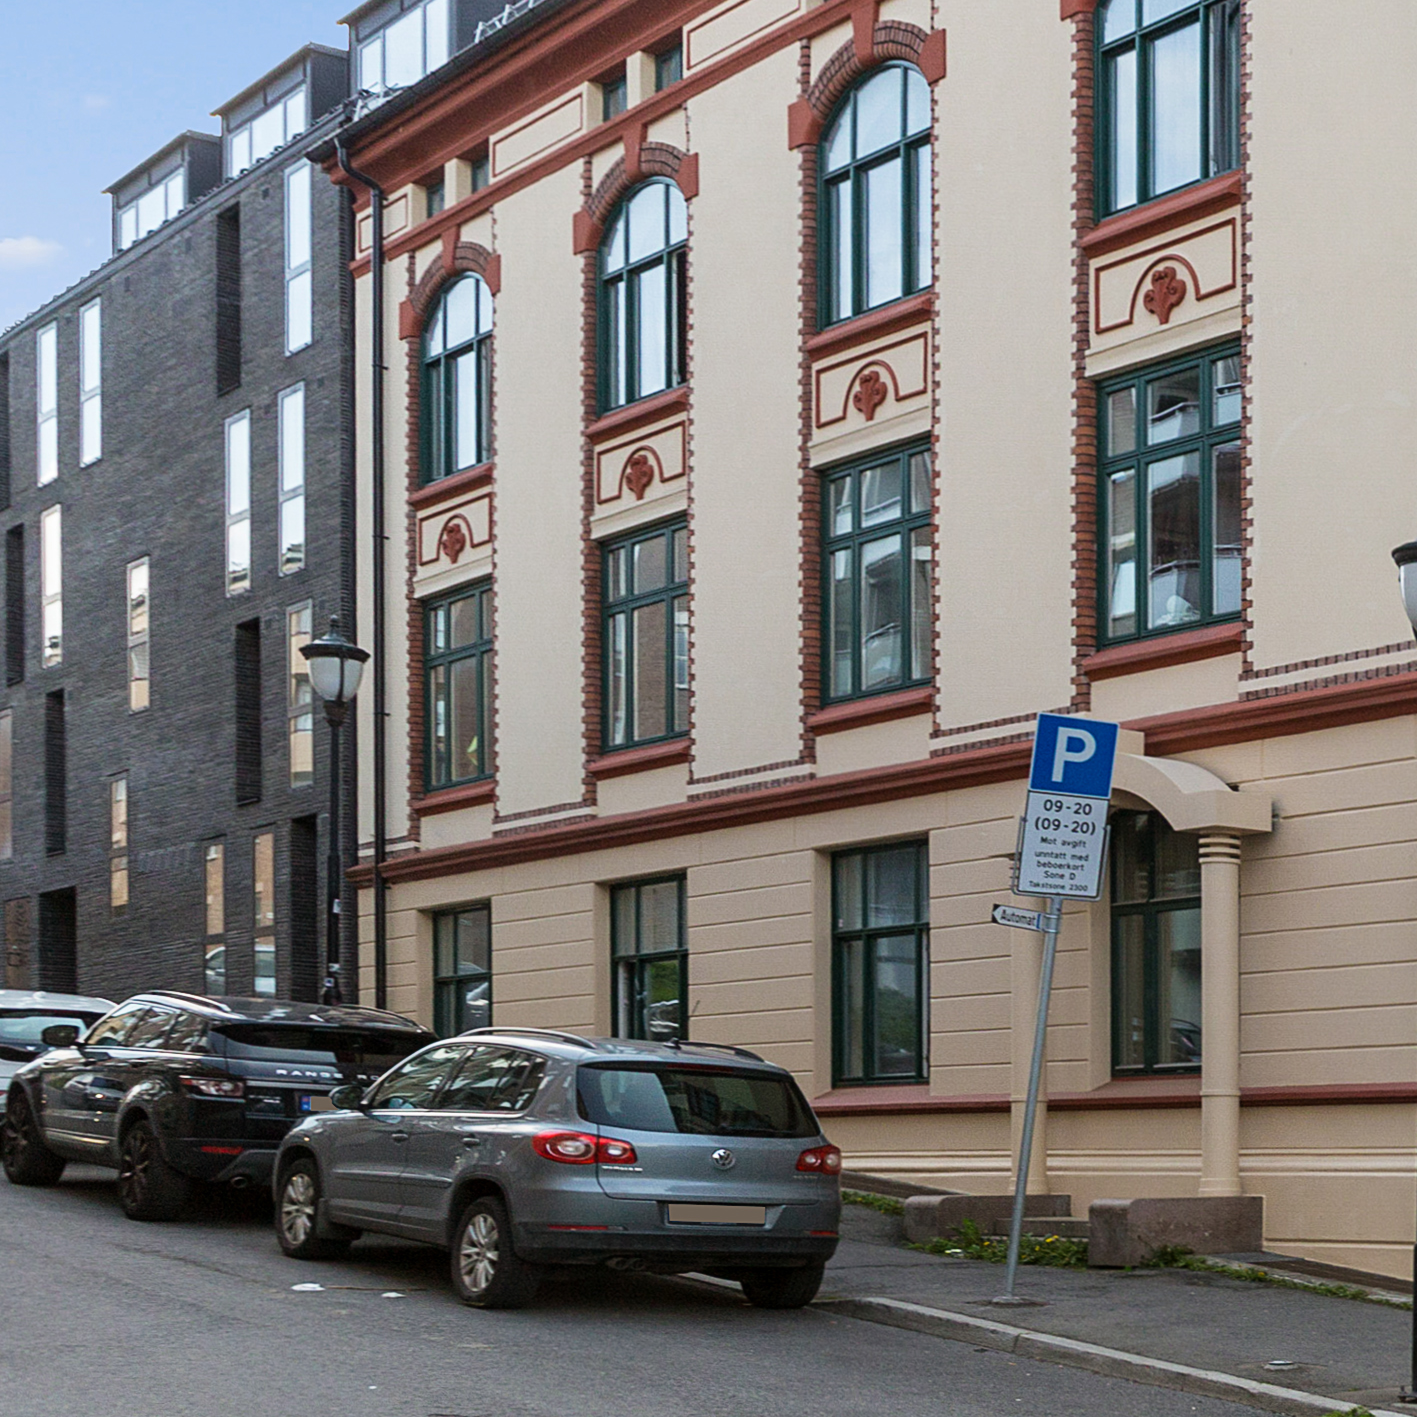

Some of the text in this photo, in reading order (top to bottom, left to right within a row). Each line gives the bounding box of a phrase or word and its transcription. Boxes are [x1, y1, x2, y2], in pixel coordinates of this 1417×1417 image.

[1051, 726, 1097, 783] P
[1040, 836, 1087, 849] Mot avgift
[1034, 850, 1090, 862] unntatt med
[1036, 860, 1085, 871] beboerkort
[1043, 870, 1077, 881] Sone D
[1069, 883, 1089, 892] 2300
[1001, 909, 1036, 926] Automat
[275, 1068, 344, 1080] RANGE
